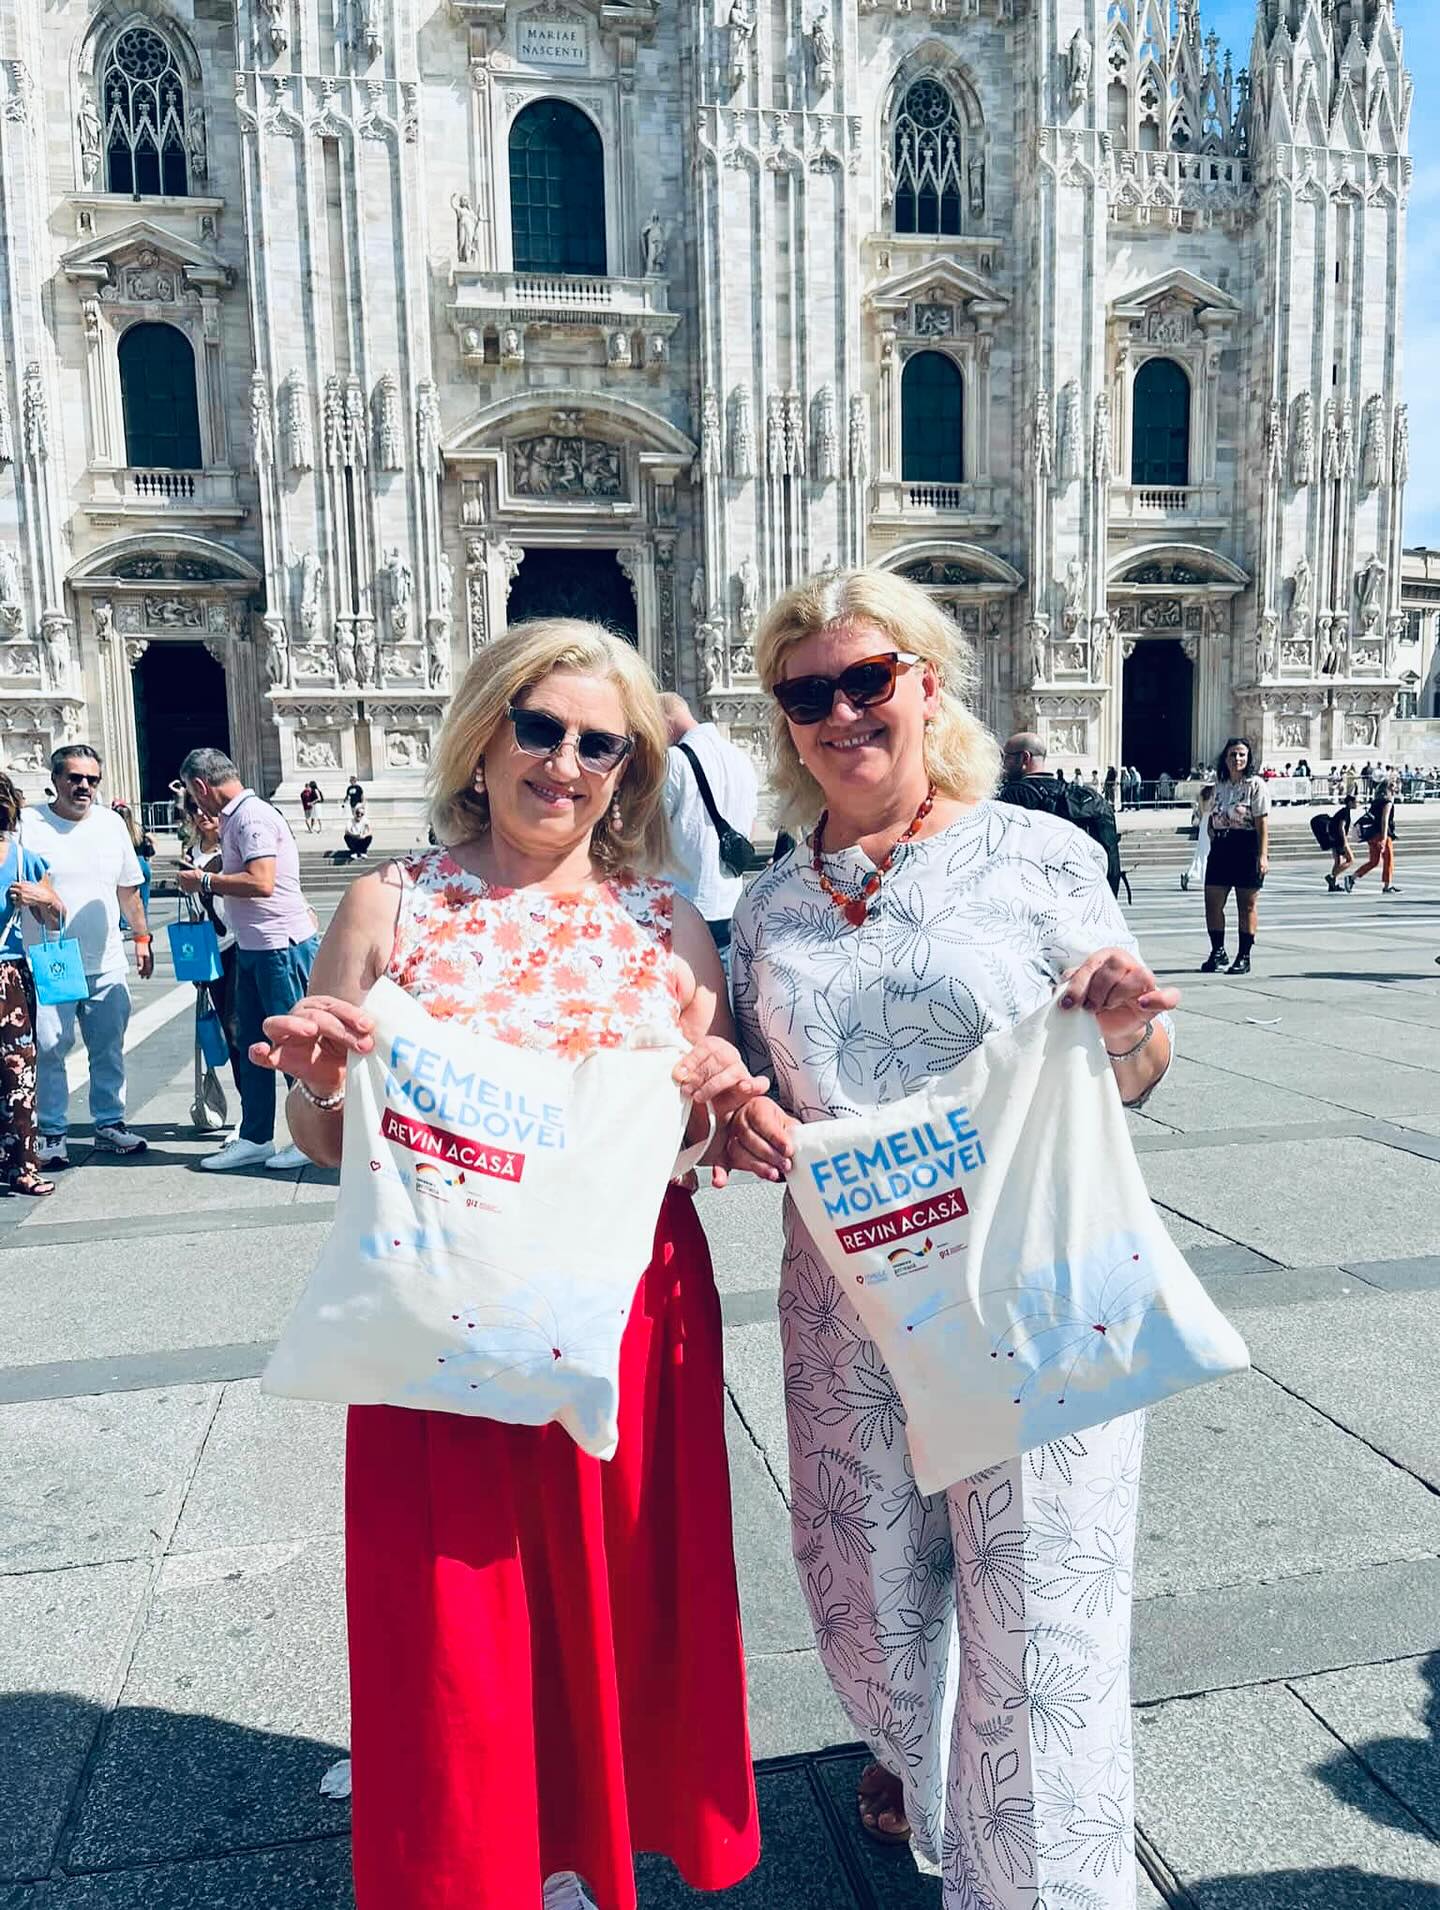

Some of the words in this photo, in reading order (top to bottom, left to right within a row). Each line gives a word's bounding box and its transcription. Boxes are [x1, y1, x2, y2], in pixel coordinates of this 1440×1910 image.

[522, 44, 583, 58] NASCENTI
[528, 29, 576, 41] MARIAE
[385, 1075, 566, 1149] MOLDOVEI
[390, 1035, 564, 1127] FEMEILE
[388, 1118, 443, 1154] REVIN
[446, 1143, 515, 1177] ACASĂ
[810, 1106, 978, 1193] FEMEILE
[822, 1139, 987, 1221] MOLDOVEI
[843, 1222, 897, 1250] REVIN
[901, 1193, 963, 1233] ACASĂ
